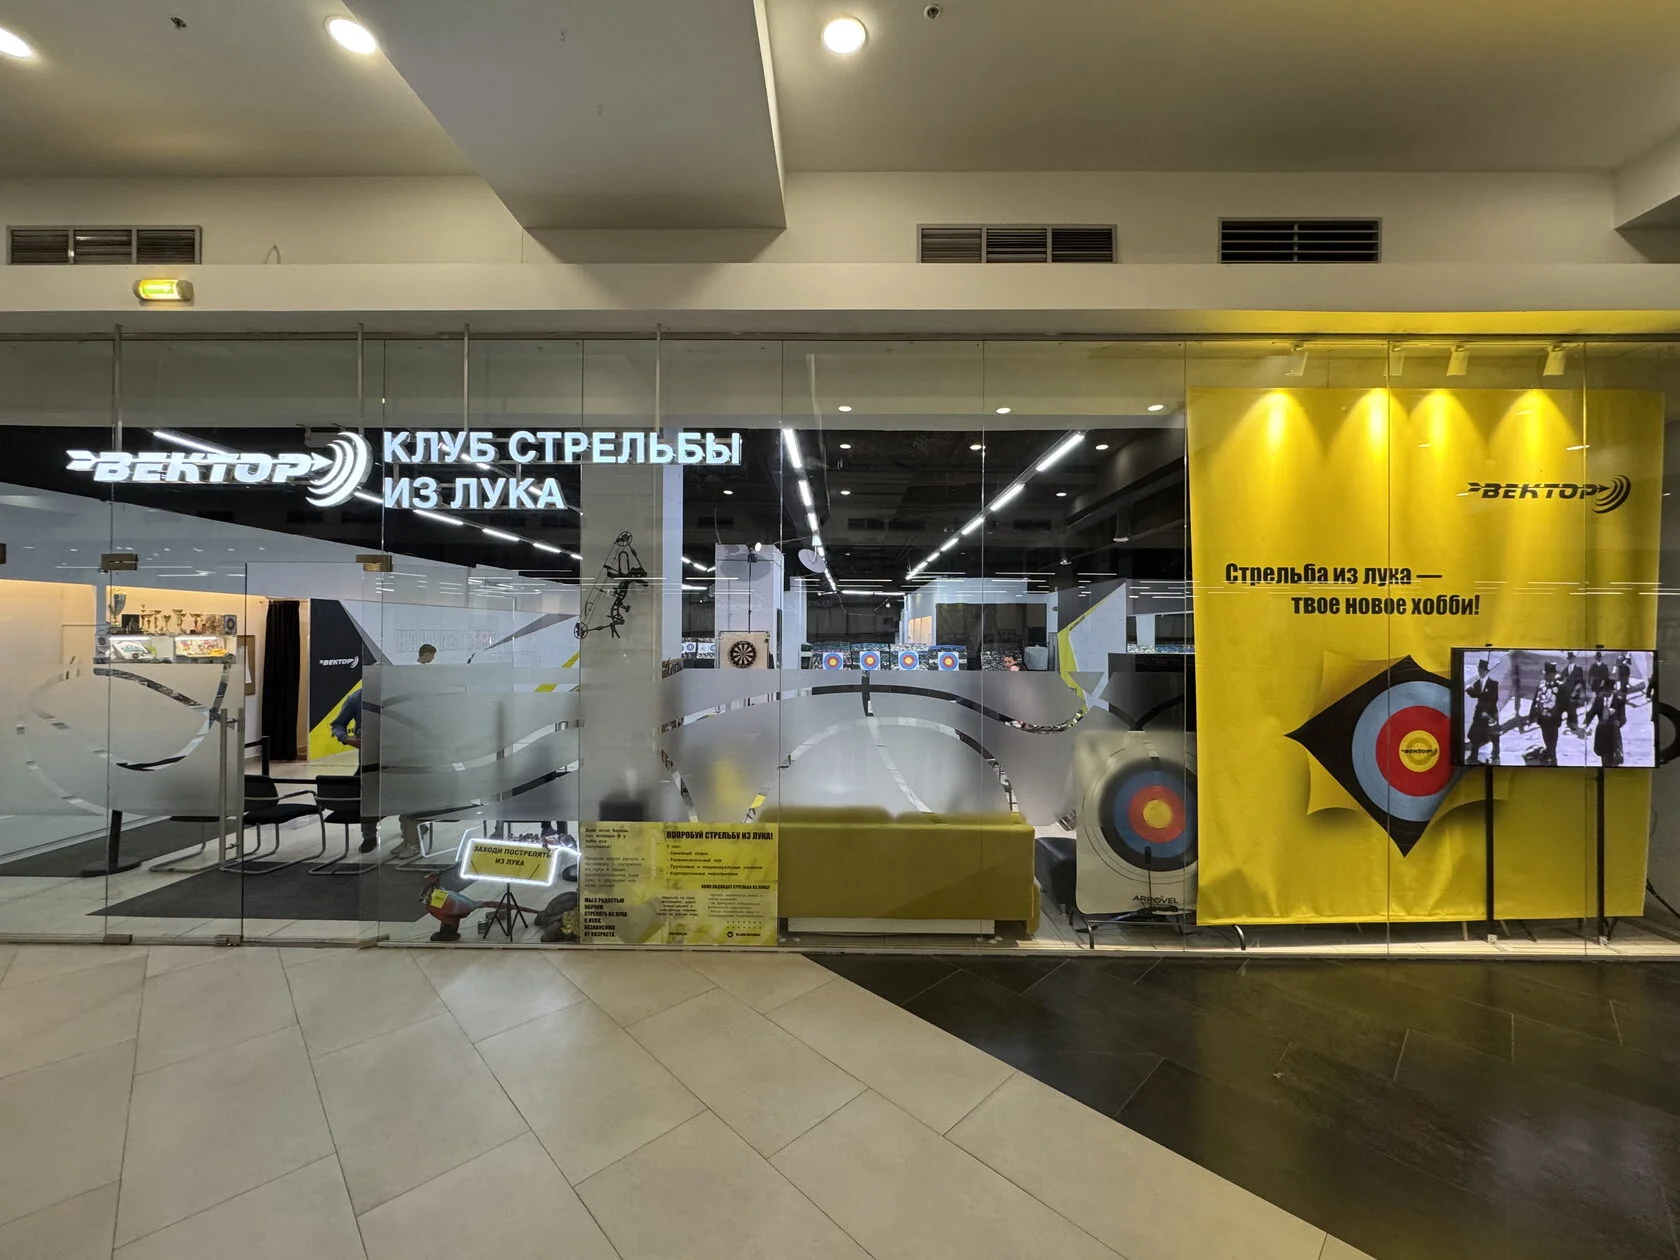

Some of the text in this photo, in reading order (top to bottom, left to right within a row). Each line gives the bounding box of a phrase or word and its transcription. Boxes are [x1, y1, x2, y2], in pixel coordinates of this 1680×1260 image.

[384, 431, 741, 464] КЛУБ СТРЕЛЬБЫ
[93, 451, 312, 482] ВЕКТОР
[384, 477, 566, 509] ИЗ ЛУКА
[1481, 482, 1598, 500] ВЕКТОР
[1225, 563, 1331, 586] Стрельба
[1333, 568, 1358, 584] из
[1363, 568, 1412, 586] лука
[1292, 595, 1480, 616] твое новое хобби!
[666, 830, 704, 839] ПОПРОБУЙ
[752, 832, 774, 840] ЛУКА!
[474, 845, 551, 858] ЗАХОДИ ПОСТРЕЛЯТЬ
